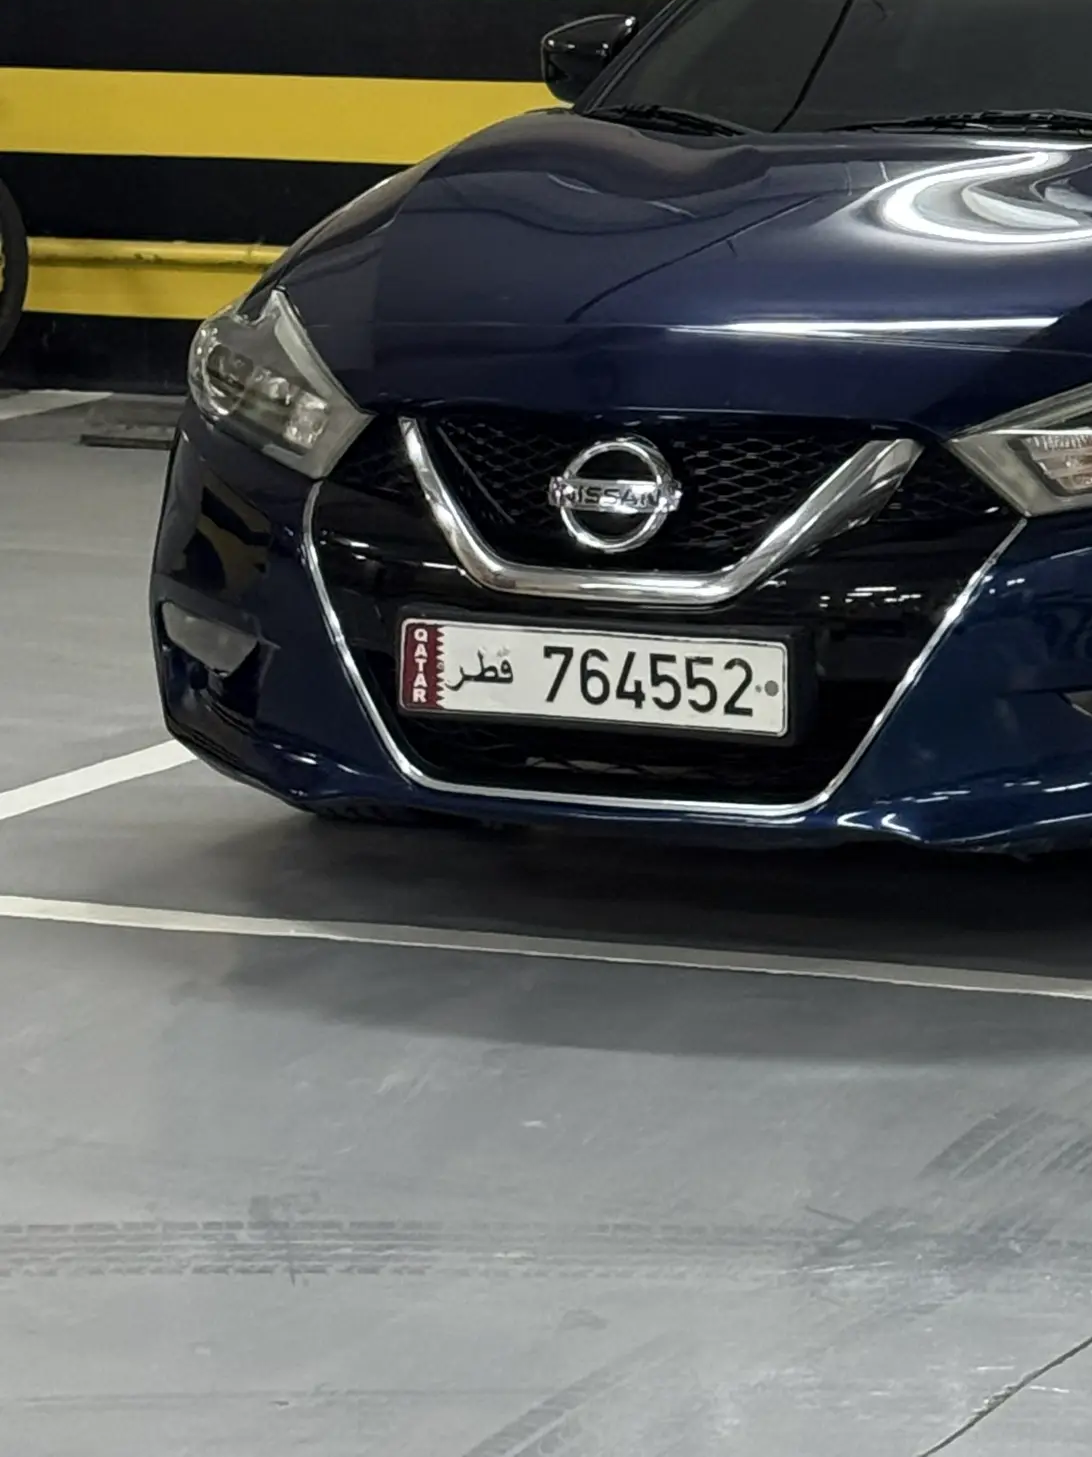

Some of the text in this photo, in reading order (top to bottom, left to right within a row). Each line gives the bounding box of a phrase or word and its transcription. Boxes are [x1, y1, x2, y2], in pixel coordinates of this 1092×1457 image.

[413, 628, 428, 703] QATAR
[444, 647, 513, 691] قطر
[543, 645, 754, 717] 764552
